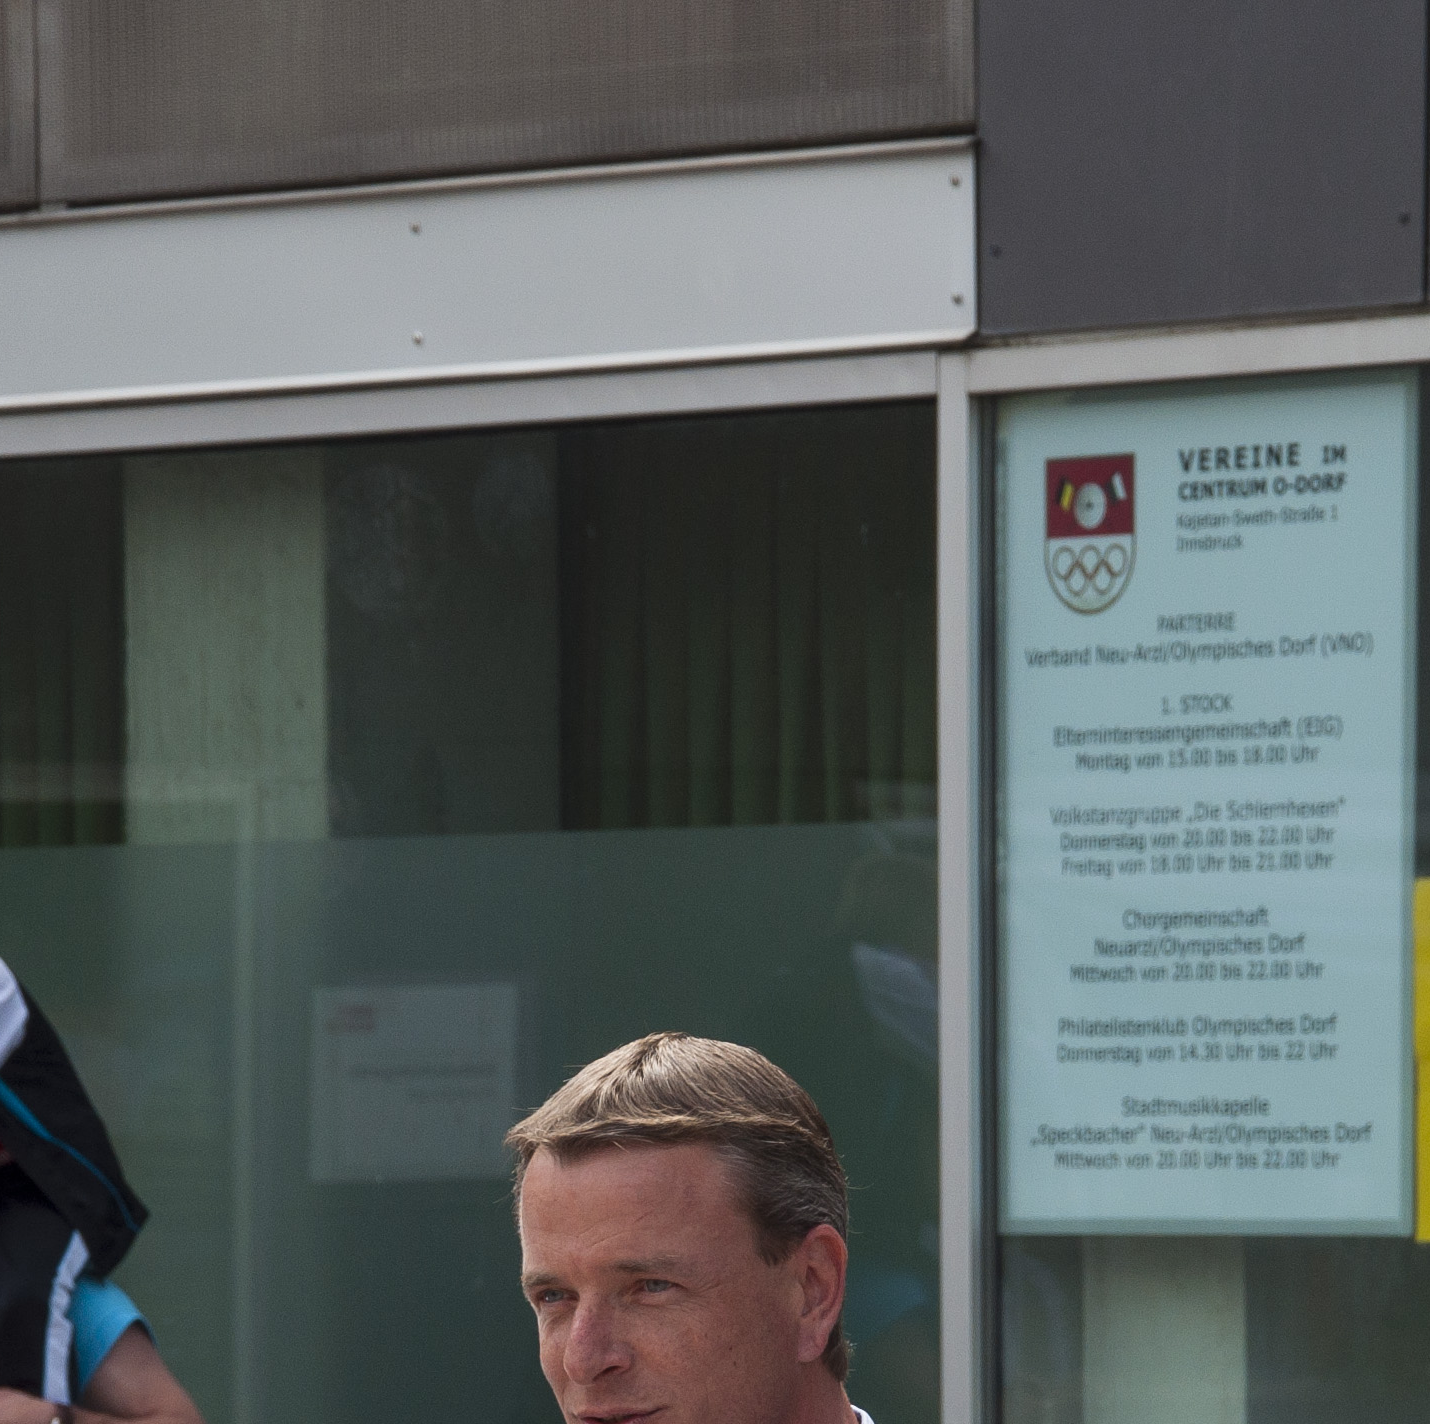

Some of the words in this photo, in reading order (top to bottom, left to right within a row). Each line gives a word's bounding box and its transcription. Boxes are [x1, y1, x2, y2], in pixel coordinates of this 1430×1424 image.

[1178, 441, 1301, 473] VEREINE
[1323, 444, 1347, 464] IM
[1178, 478, 1268, 501] CENTRUM
[1273, 471, 1346, 495] O-DORF
[1177, 534, 1244, 551] Innsbruck
[1157, 612, 1235, 632] PARTERRE
[1025, 646, 1092, 667] Verband
[1279, 633, 1317, 656] Dorf
[1180, 692, 1233, 714] STOCK
[1075, 752, 1131, 774] Montag
[1135, 752, 1164, 769] von
[1215, 748, 1239, 767] bis
[1291, 742, 1321, 764] Uhr
[1060, 831, 1146, 854] Donnerstag
[1151, 832, 1178, 849] von
[1230, 828, 1253, 847] bis
[1257, 824, 1303, 846] 22.00
[1306, 823, 1336, 845] Uhr
[1061, 856, 1114, 880] Freitag
[1117, 858, 1146, 875] von
[1197, 852, 1227, 873] Uhr
[1229, 851, 1253, 873] bis
[1305, 848, 1334, 870] Uhr
[1122, 905, 1269, 932] Chorgemeinschaft
[1269, 932, 1307, 954] Dorf
[1070, 963, 1136, 983] Mittwoch
[1139, 964, 1167, 981] von
[1220, 961, 1243, 981] bis
[1247, 959, 1292, 981] 22.00
[1295, 958, 1325, 980] Uhr
[1058, 1015, 1189, 1038] Philatelistenklub
[1192, 1013, 1295, 1037] Olympisches
[1300, 1011, 1338, 1034] Dorf
[1057, 1043, 1142, 1067] Donnerstag
[1146, 1045, 1173, 1062] von
[1226, 1041, 1254, 1061] Uhr
[1257, 1042, 1280, 1060] bis
[1285, 1039, 1305, 1060] 22
[1309, 1040, 1340, 1060] Uhr
[1122, 1094, 1271, 1118] Stadtmusikkapelle
[1335, 1120, 1374, 1143] Dorf
[1054, 1151, 1120, 1171] Mittwoch
[1124, 1152, 1153, 1170] von
[1204, 1149, 1232, 1170] Uhr
[1236, 1150, 1259, 1170] bis
[1311, 1149, 1341, 1169] Uhr
